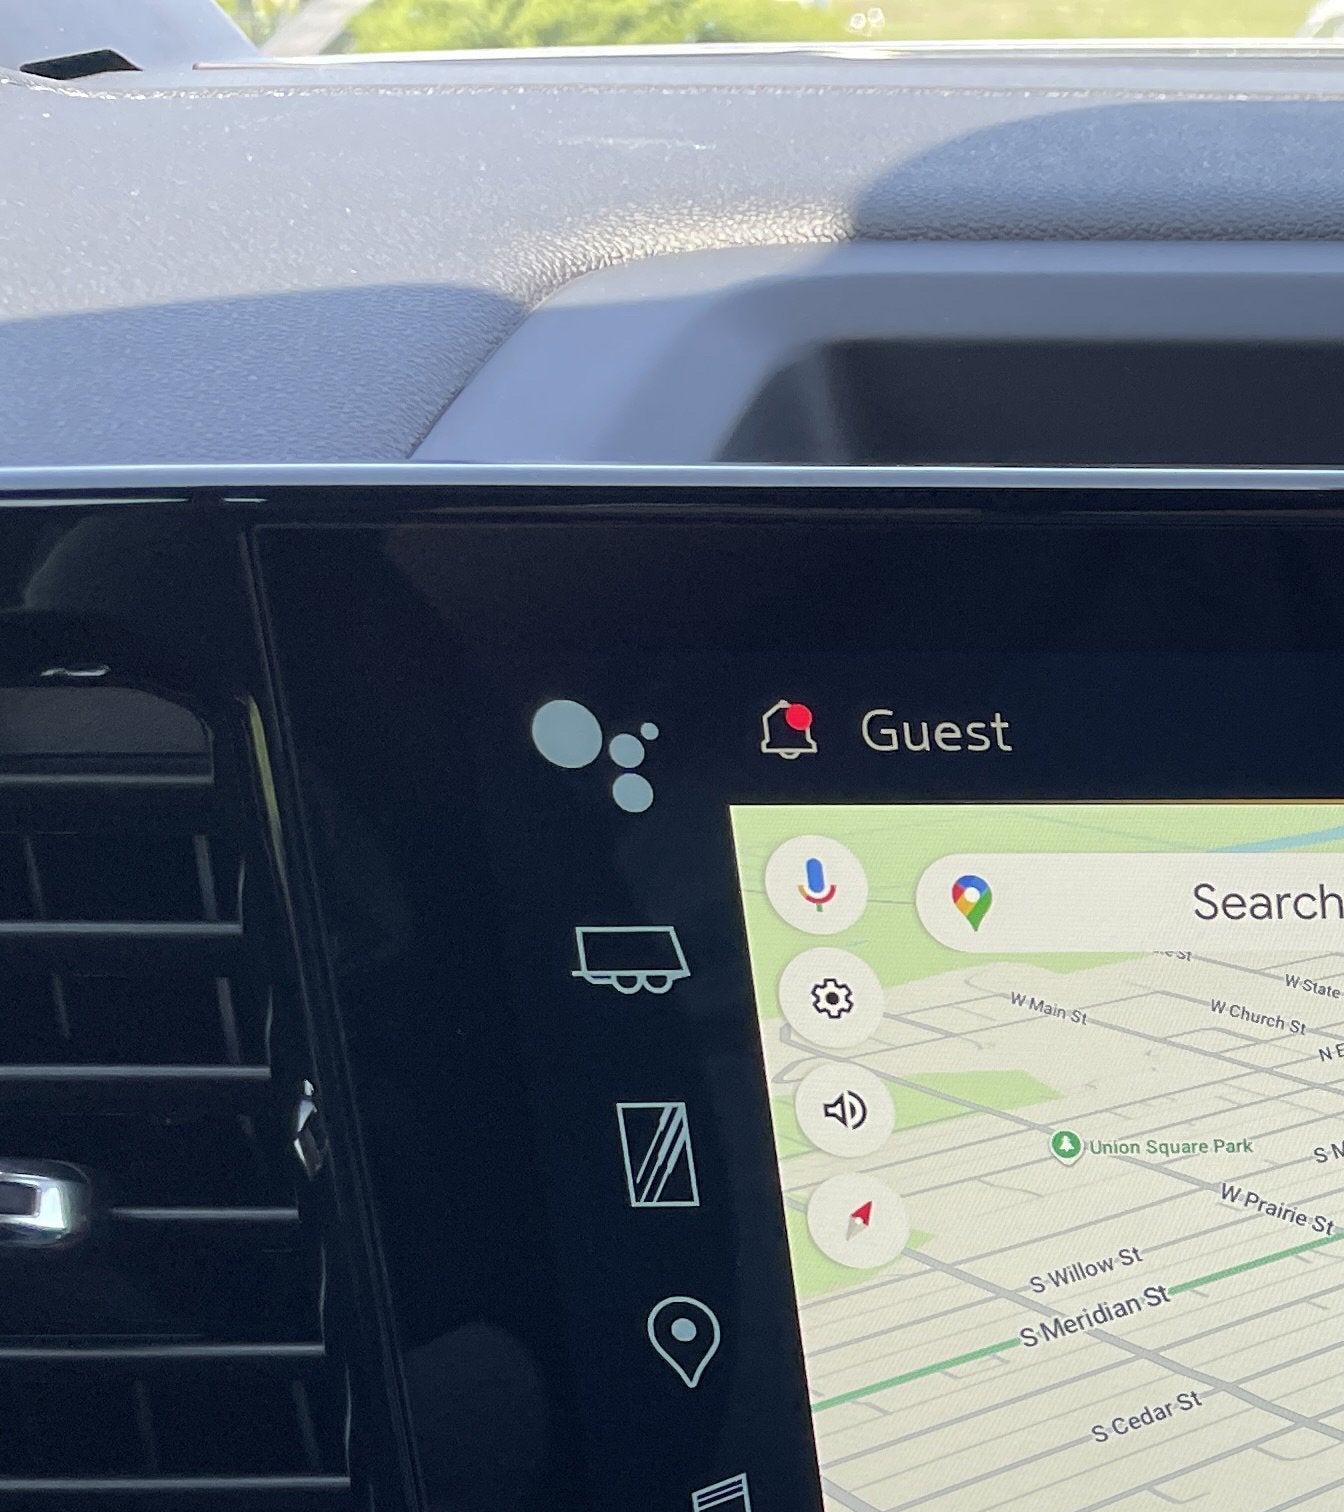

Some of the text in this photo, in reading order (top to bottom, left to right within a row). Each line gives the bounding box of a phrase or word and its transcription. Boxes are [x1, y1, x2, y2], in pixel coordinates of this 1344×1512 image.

[862, 709, 1012, 752] Guest
[1194, 883, 1344, 920] Search
[1011, 992, 1088, 1026] W Main St
[1089, 1139, 1253, 1157] Union Square Park
[1313, 1147, 1329, 1163] S
[1221, 1183, 1335, 1235] W Prairie St
[1030, 1247, 1143, 1293] S Willow St
[1020, 1286, 1170, 1347] S Meridian St
[1091, 1391, 1202, 1442] S Cedar St
